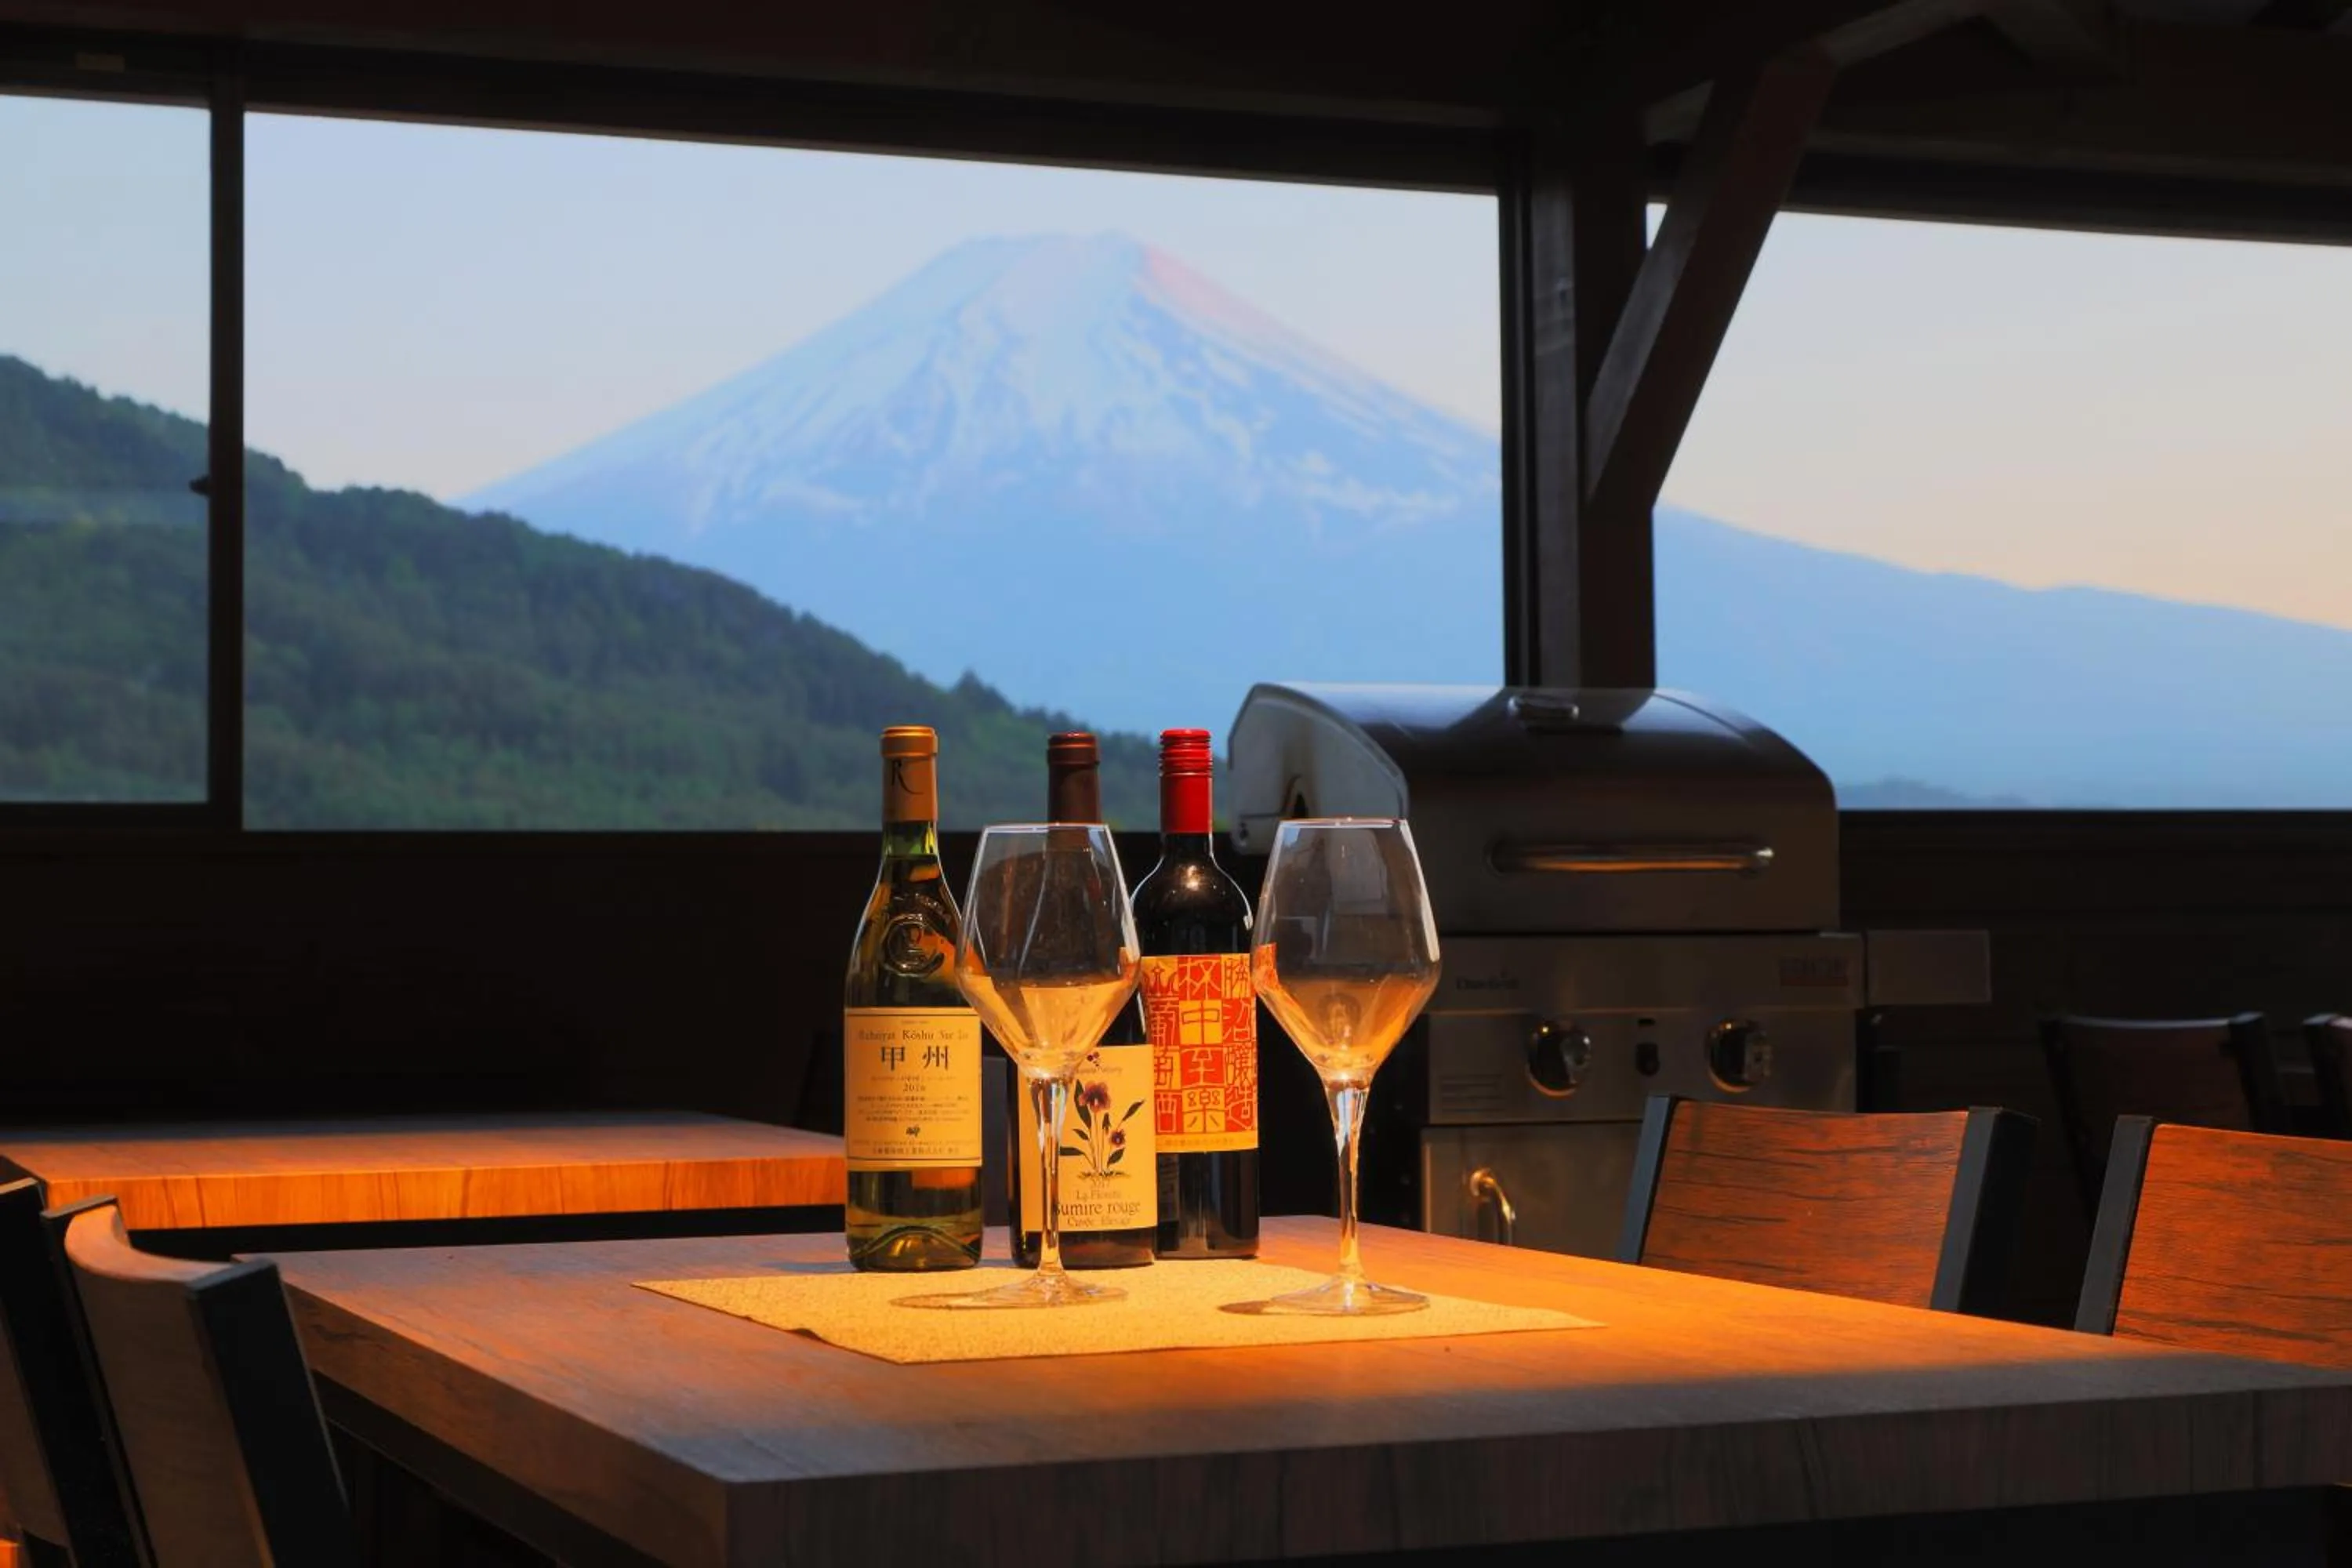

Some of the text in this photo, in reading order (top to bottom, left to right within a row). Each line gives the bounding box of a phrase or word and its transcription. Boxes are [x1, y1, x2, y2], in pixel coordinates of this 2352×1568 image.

[891, 759, 924, 795] R
[880, 1045, 949, 1071] 甲州
[1107, 1201, 1141, 1216] rouge
